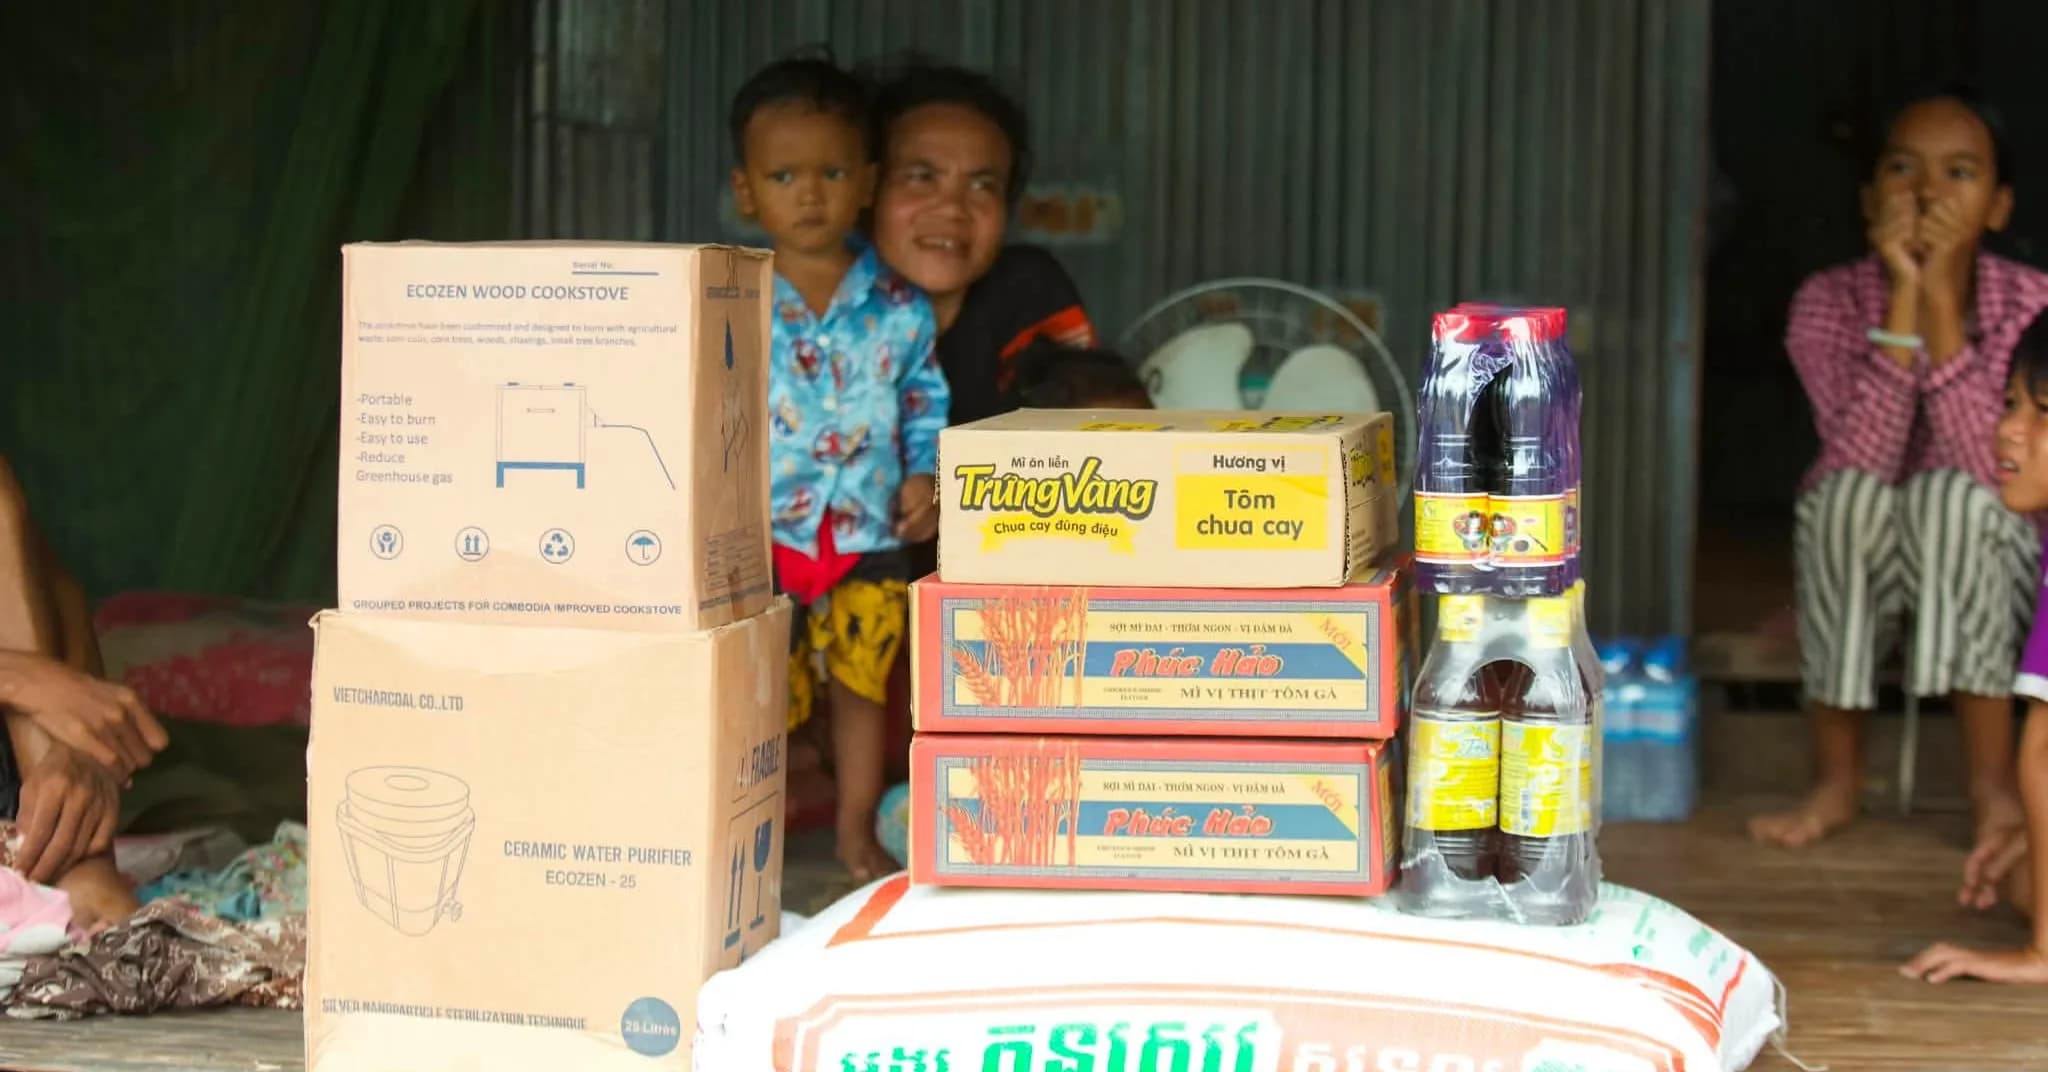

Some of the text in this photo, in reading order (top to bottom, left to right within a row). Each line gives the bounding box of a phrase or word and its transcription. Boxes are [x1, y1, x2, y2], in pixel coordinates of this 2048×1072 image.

[406, 284, 629, 301] ECOZEN WOOD COOKSTOVE
[390, 414, 404, 425] to
[407, 413, 436, 425] burn
[390, 433, 404, 444] to
[407, 434, 430, 445] use
[1213, 454, 1286, 473] Hương vị
[356, 469, 454, 486] Greenhouse gas
[1223, 488, 1277, 510] Tôm
[993, 522, 1025, 534] Chua
[1030, 521, 1050, 534] cay
[1090, 521, 1118, 538] điệu
[1196, 513, 1304, 541] chua cay
[353, 599, 406, 610] GROUPED
[409, 600, 466, 611] PROJECTS
[469, 601, 490, 611] FOR
[554, 603, 611, 614] IMPROVED
[613, 604, 682, 615] COOKSTOVE
[1200, 623, 1232, 633] NGON
[1109, 643, 1284, 678] Phúc Hảo
[333, 686, 416, 709] VIETCHARCOAL
[1180, 685, 1338, 701] MÌ VỊ THỊT TÔM GÀ
[1196, 783, 1225, 793] NGON
[1103, 804, 1275, 837] Phúc Hảo
[504, 840, 692, 867] CERAMIC WATER PURIFIER
[1173, 845, 1194, 858] MÌ
[1200, 846, 1216, 860] VỊ
[1264, 844, 1302, 860] TÔM
[1306, 846, 1330, 860] GÀ
[545, 869, 606, 887] ECOZEN
[619, 873, 637, 889] 25
[322, 997, 360, 1014] SILVER
[445, 1007, 525, 1026] STERILIZATION
[527, 1013, 587, 1031] TECHNIQUE
